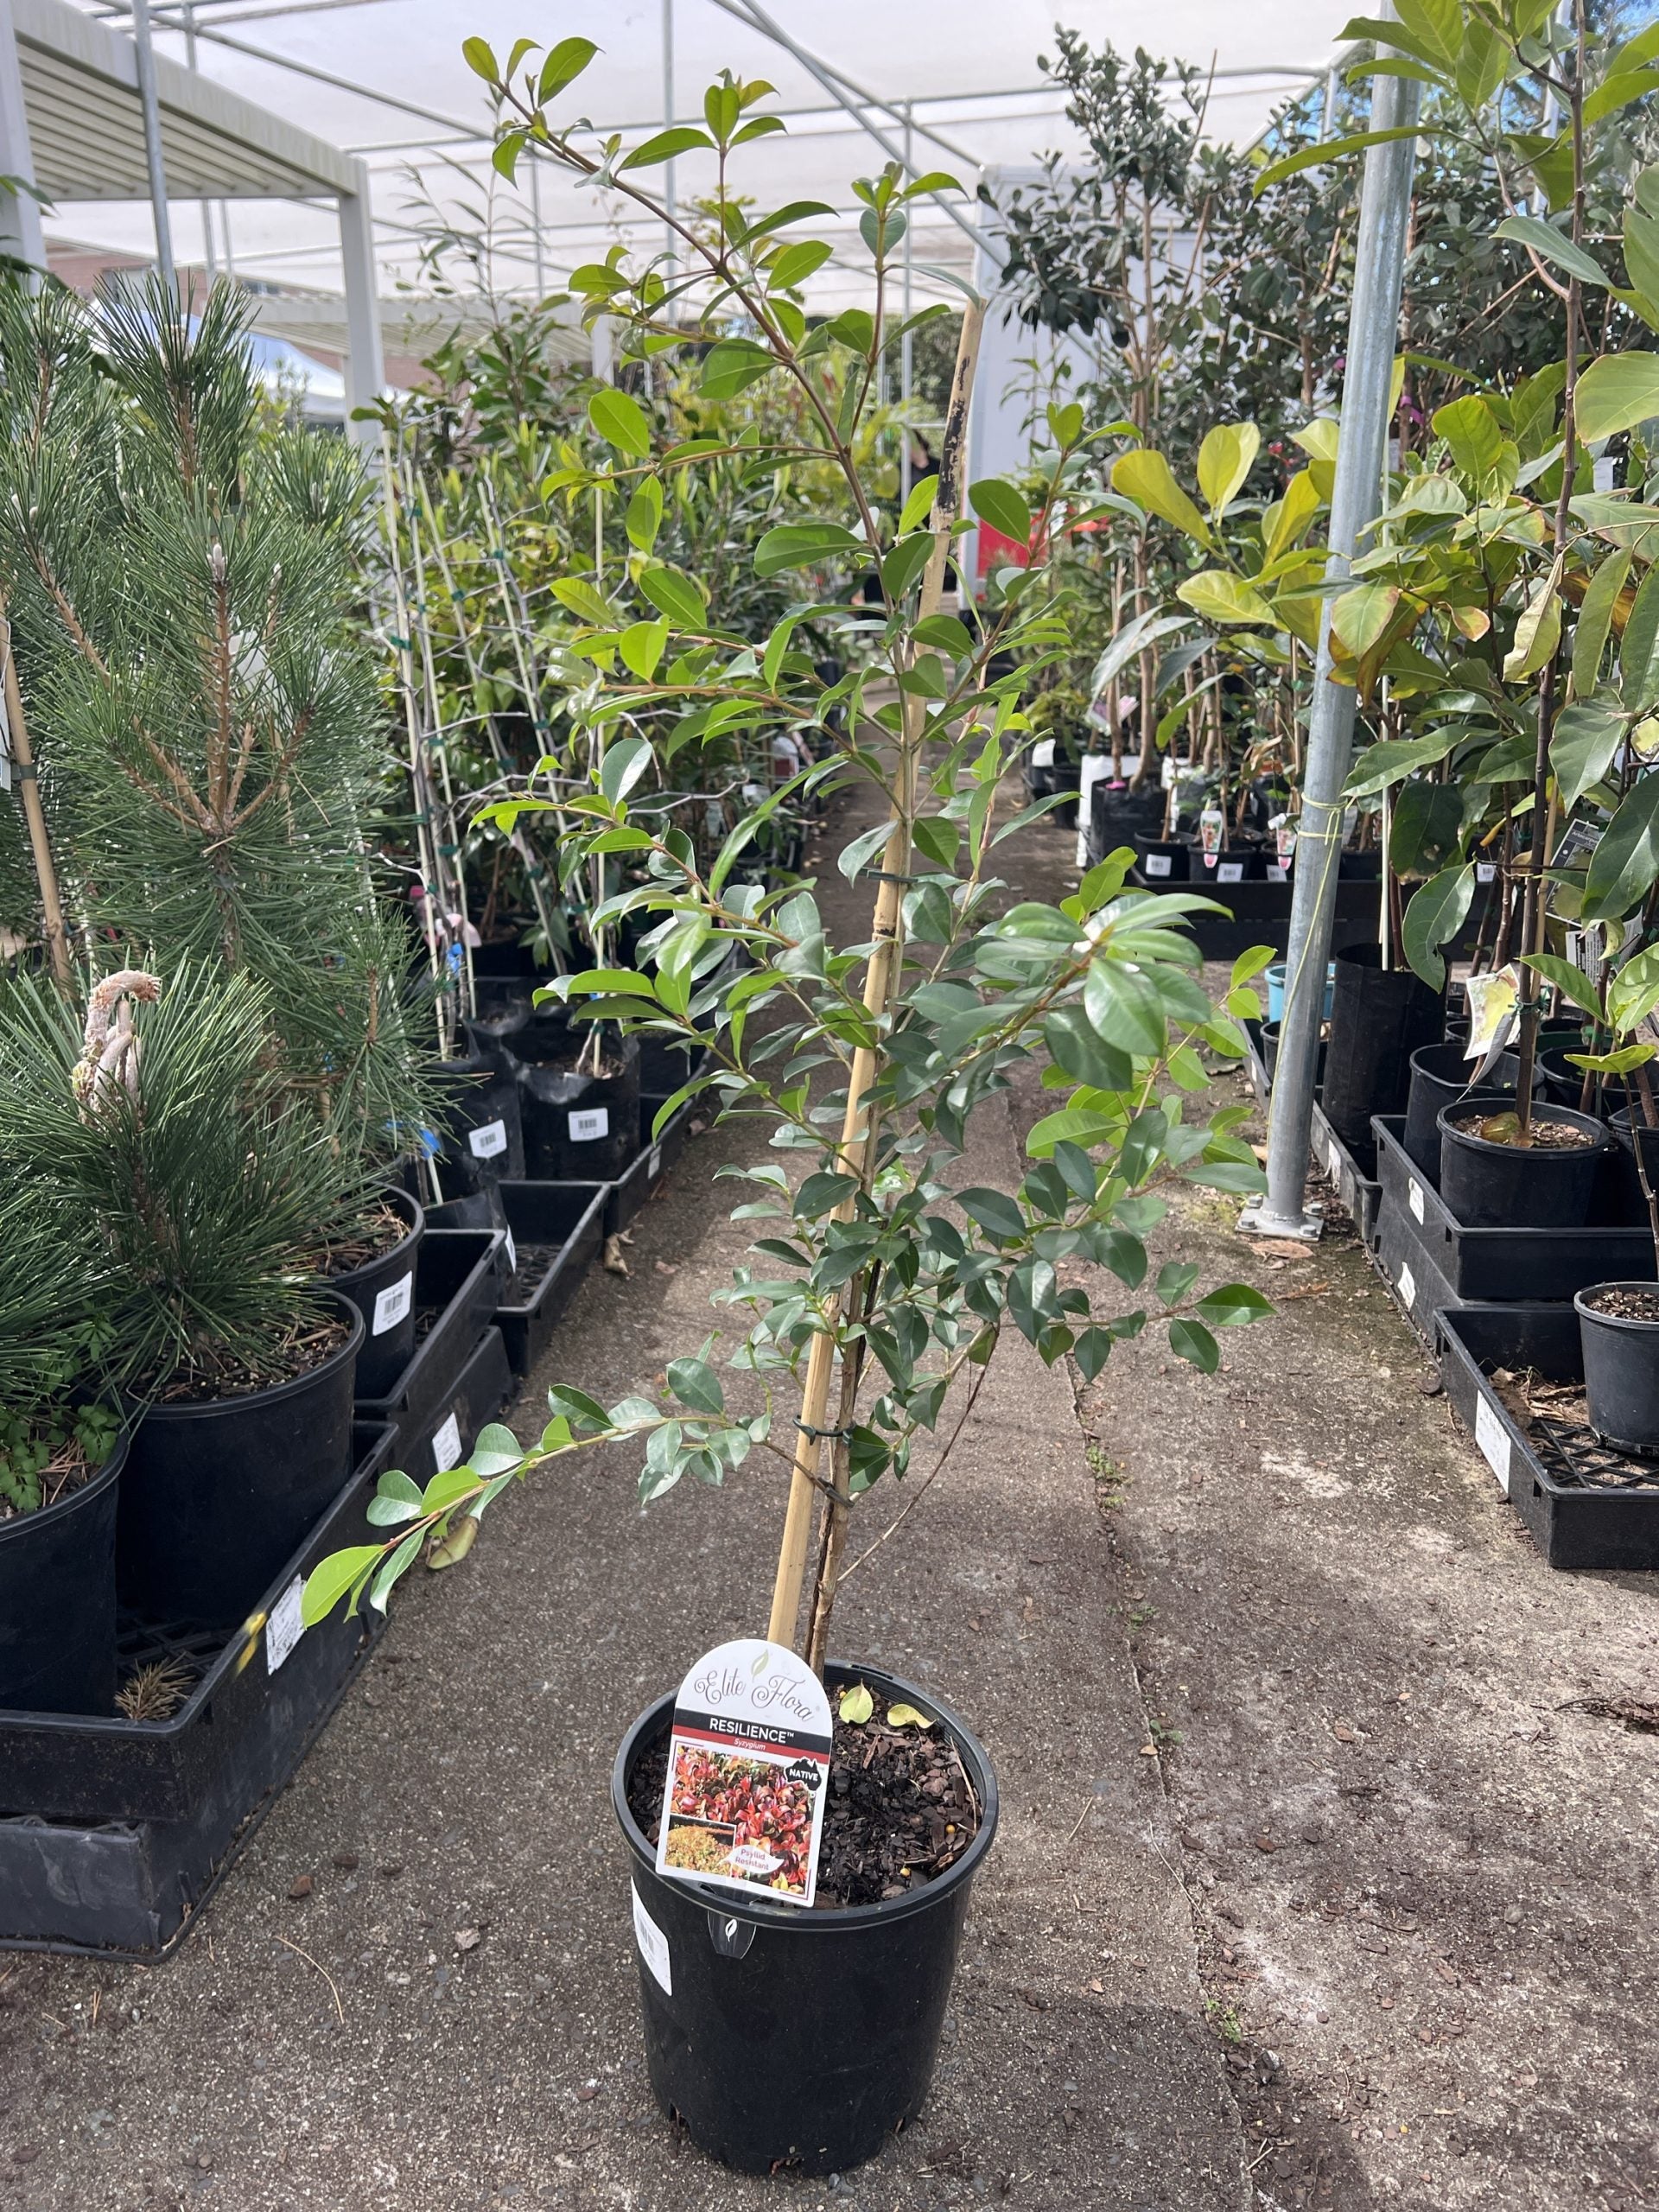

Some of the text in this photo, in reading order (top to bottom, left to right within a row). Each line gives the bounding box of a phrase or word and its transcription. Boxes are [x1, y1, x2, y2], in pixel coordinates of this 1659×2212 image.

[694, 1668, 815, 1722] Elite Flora
[734, 1738, 766, 1751] Syzygium
[789, 1768, 819, 1782] NATIVE
[741, 1848, 766, 1859] Psyllid
[734, 1856, 769, 1870] Resistant
